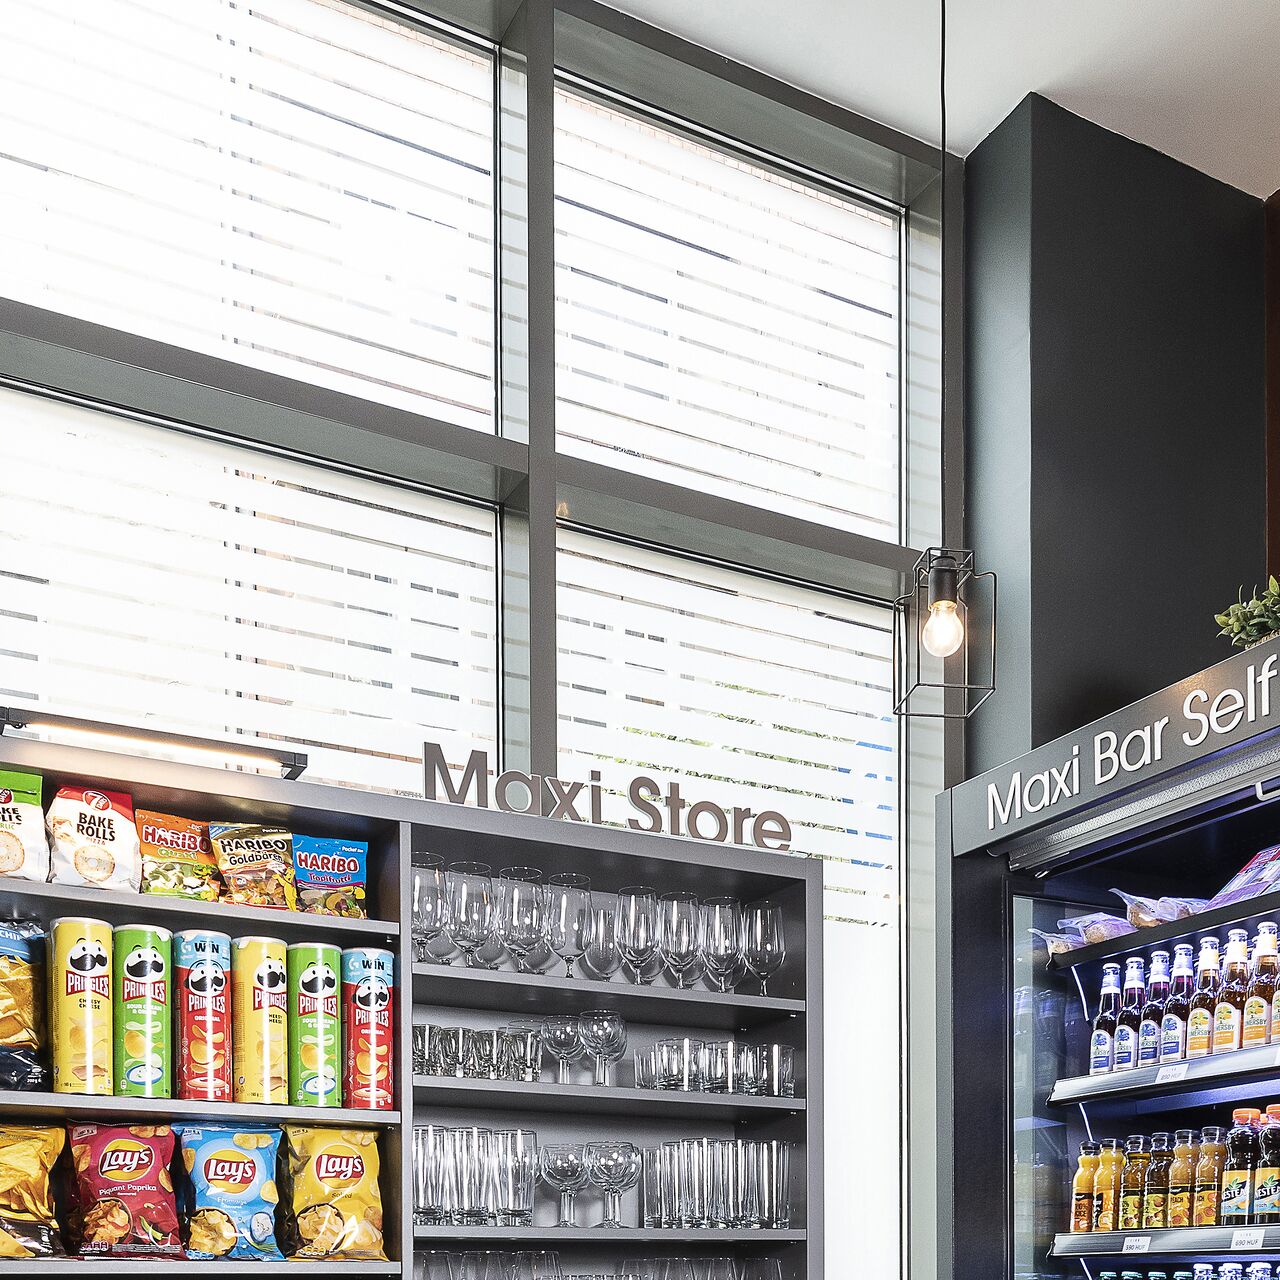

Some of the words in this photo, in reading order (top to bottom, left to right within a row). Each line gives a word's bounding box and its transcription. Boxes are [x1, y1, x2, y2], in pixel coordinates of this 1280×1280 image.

[987, 745, 1080, 830] Maxi
[1094, 717, 1163, 789] Bar
[1182, 653, 1280, 748] Self
[423, 741, 601, 824] Maxi
[628, 770, 792, 852] Store
[78, 812, 115, 831] BAKE
[76, 823, 116, 843] ROLLS
[143, 825, 212, 854] HARIBO
[220, 838, 287, 854] HARIBO
[297, 852, 359, 874] HARIBO
[102, 1147, 151, 1173] Lay's
[207, 1157, 255, 1182] Lay's
[318, 1153, 364, 1179] Lay's
[99, 1184, 127, 1197] Piquant
[128, 1183, 158, 1195] Paprika
[1136, 1242, 1146, 1250] HUF
[1235, 1239, 1246, 1247] 690
[1247, 1238, 1260, 1246] HUF
